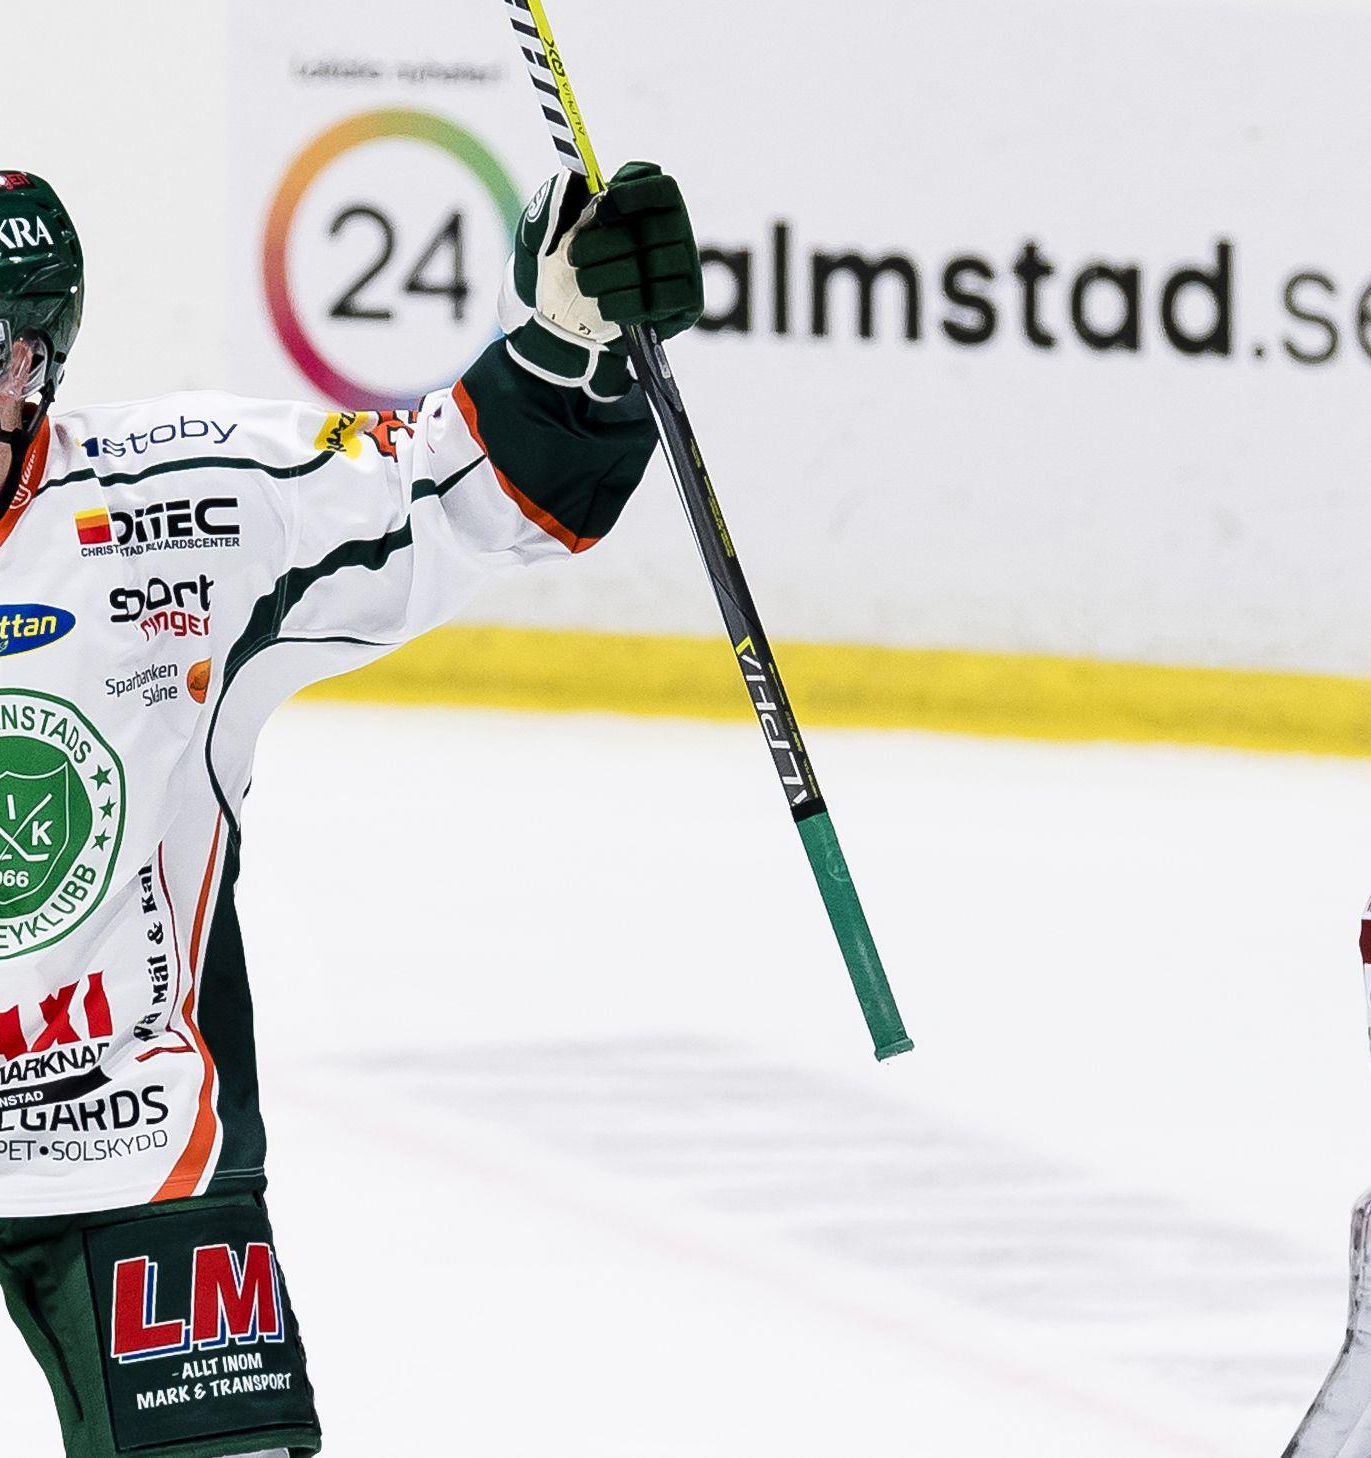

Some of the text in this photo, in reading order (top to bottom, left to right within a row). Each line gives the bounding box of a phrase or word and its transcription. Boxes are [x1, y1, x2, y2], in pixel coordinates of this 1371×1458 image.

[325, 203, 469, 322] 24
[697, 220, 1371, 366] almstad.s
[734, 635, 808, 807] ALPHA
[52, 1129, 169, 1162] SOLSKYDD
[110, 1241, 285, 1365] LM
[136, 1371, 292, 1410] MARK & TRANSPORT
[222, 1352, 263, 1374] INOM
